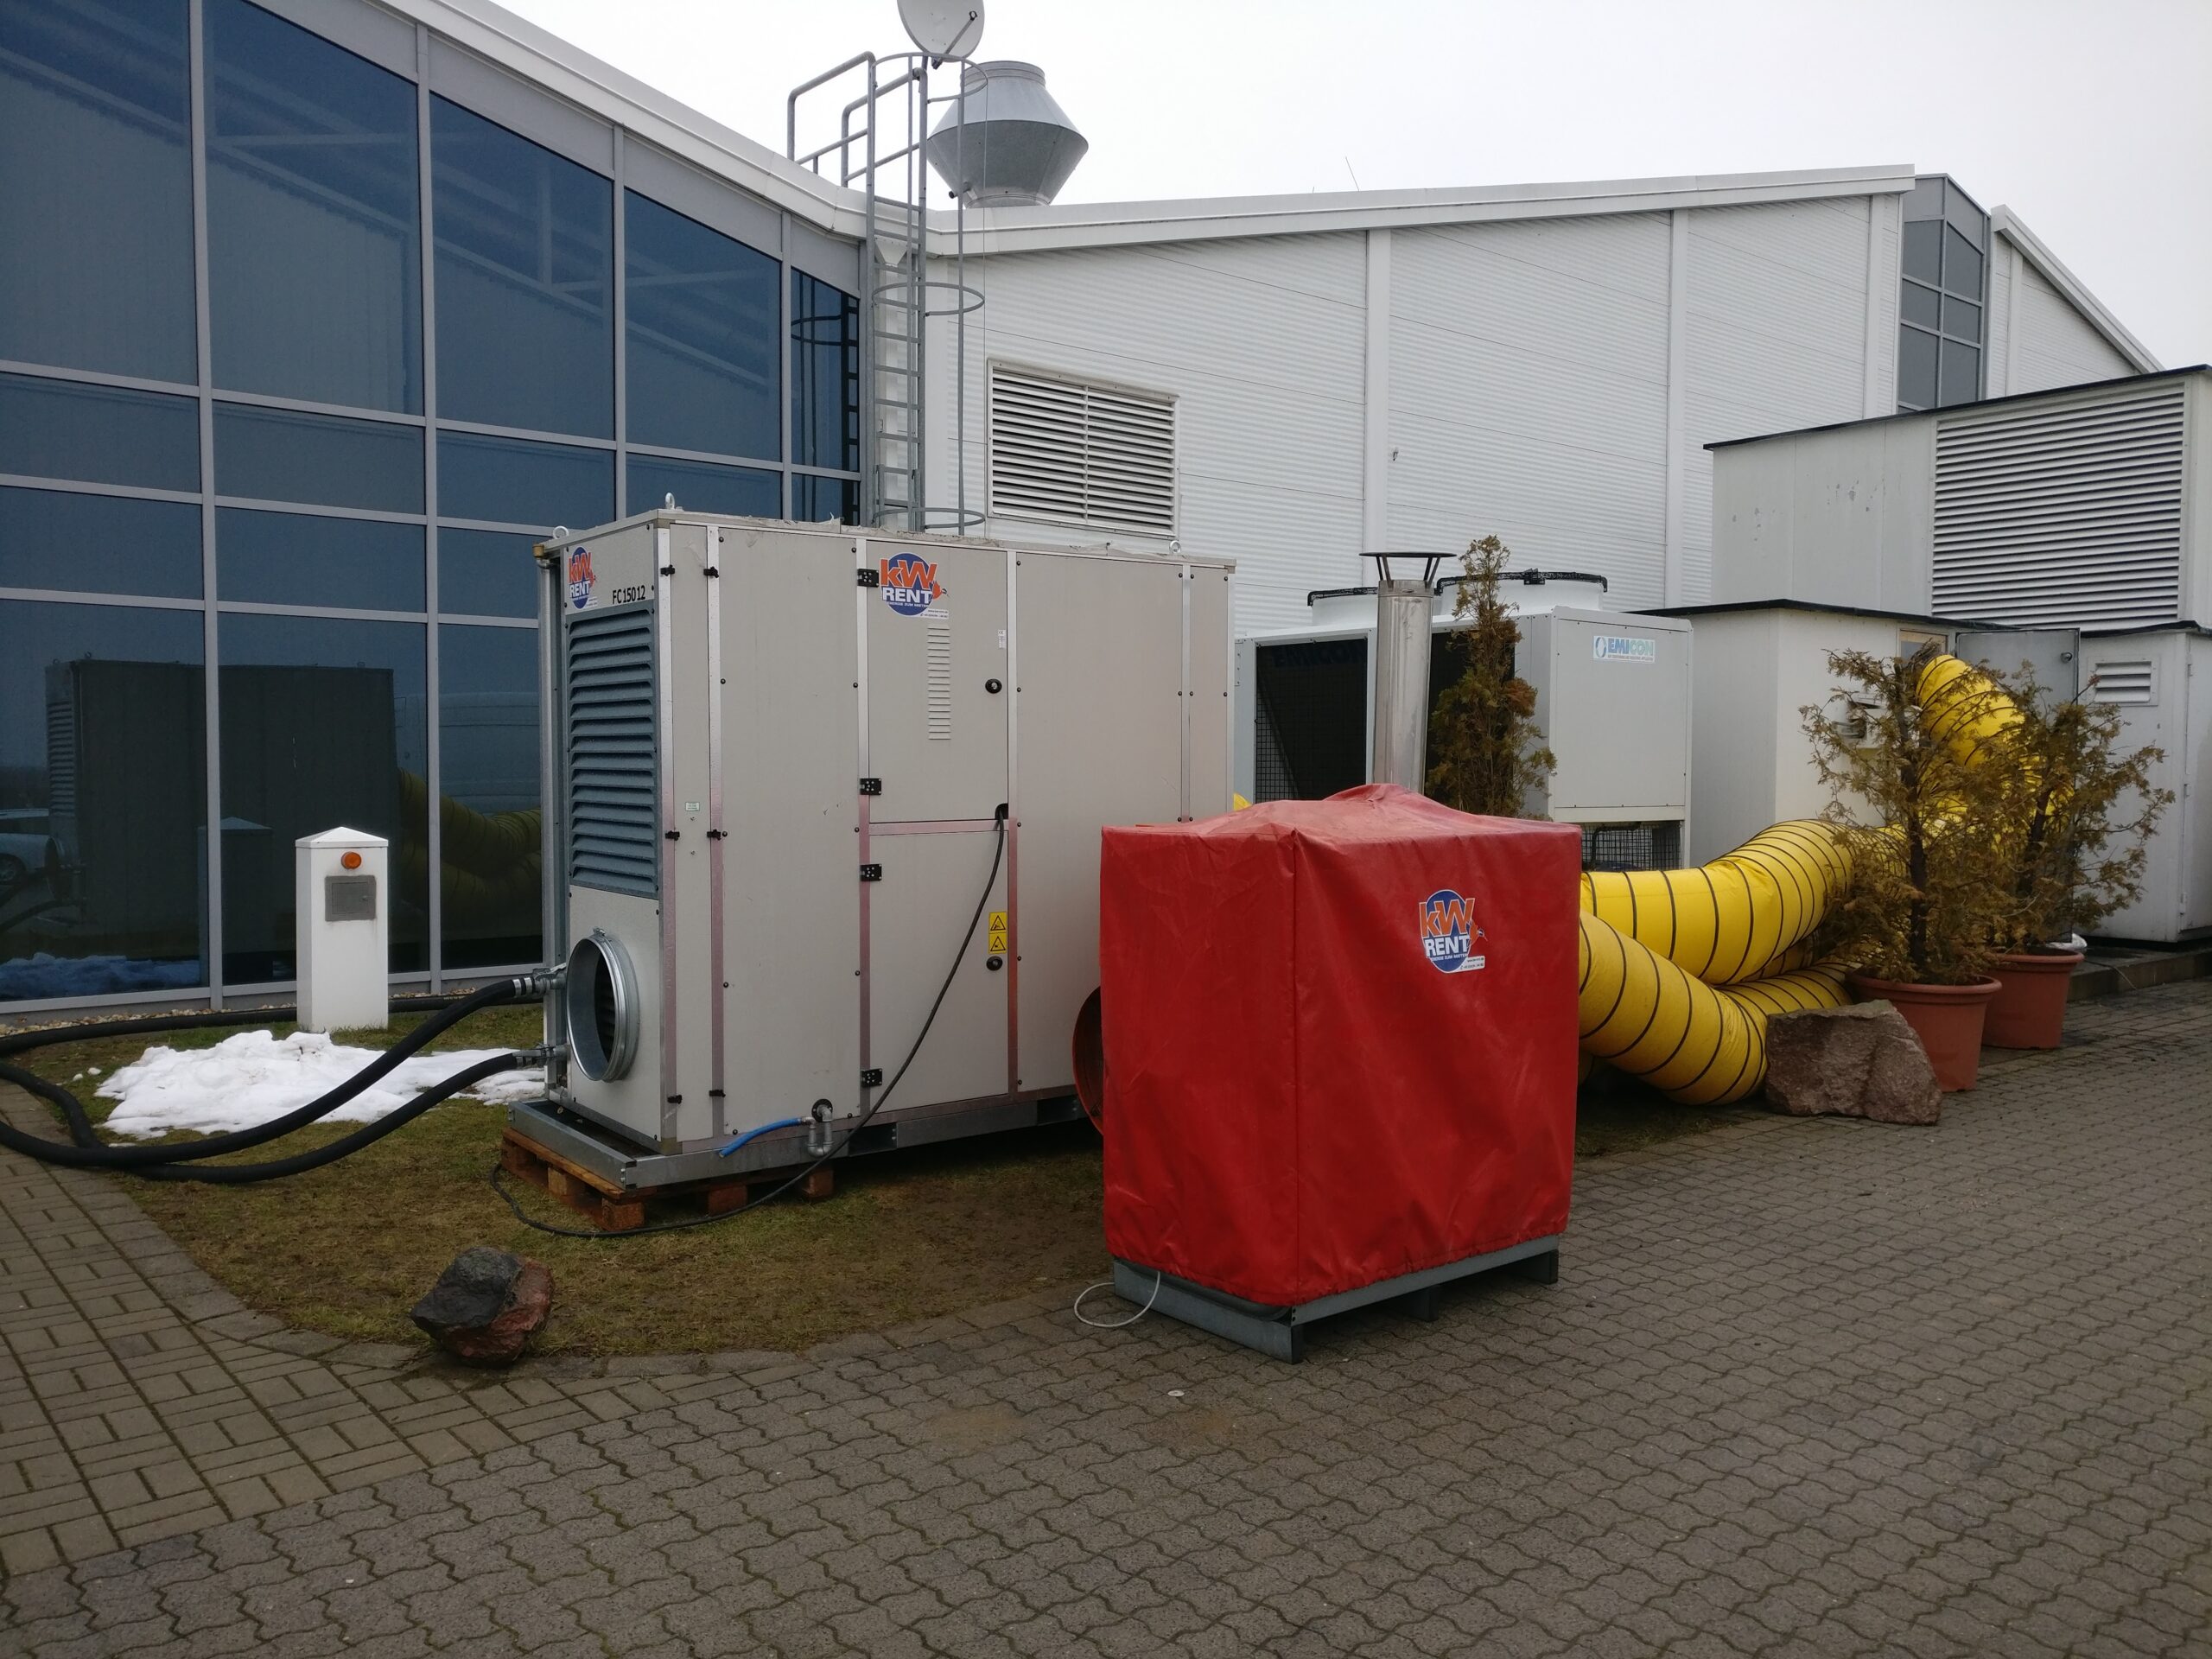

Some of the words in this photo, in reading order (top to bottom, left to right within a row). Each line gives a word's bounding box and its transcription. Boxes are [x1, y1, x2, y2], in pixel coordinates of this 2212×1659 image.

[568, 552, 592, 583] kW
[879, 558, 938, 589] kW
[569, 581, 590, 598] RENT
[882, 588, 933, 604] RENT
[1608, 638, 1654, 656] EMICON
[1419, 898, 1476, 939] kW
[1424, 935, 1471, 958] RENT
